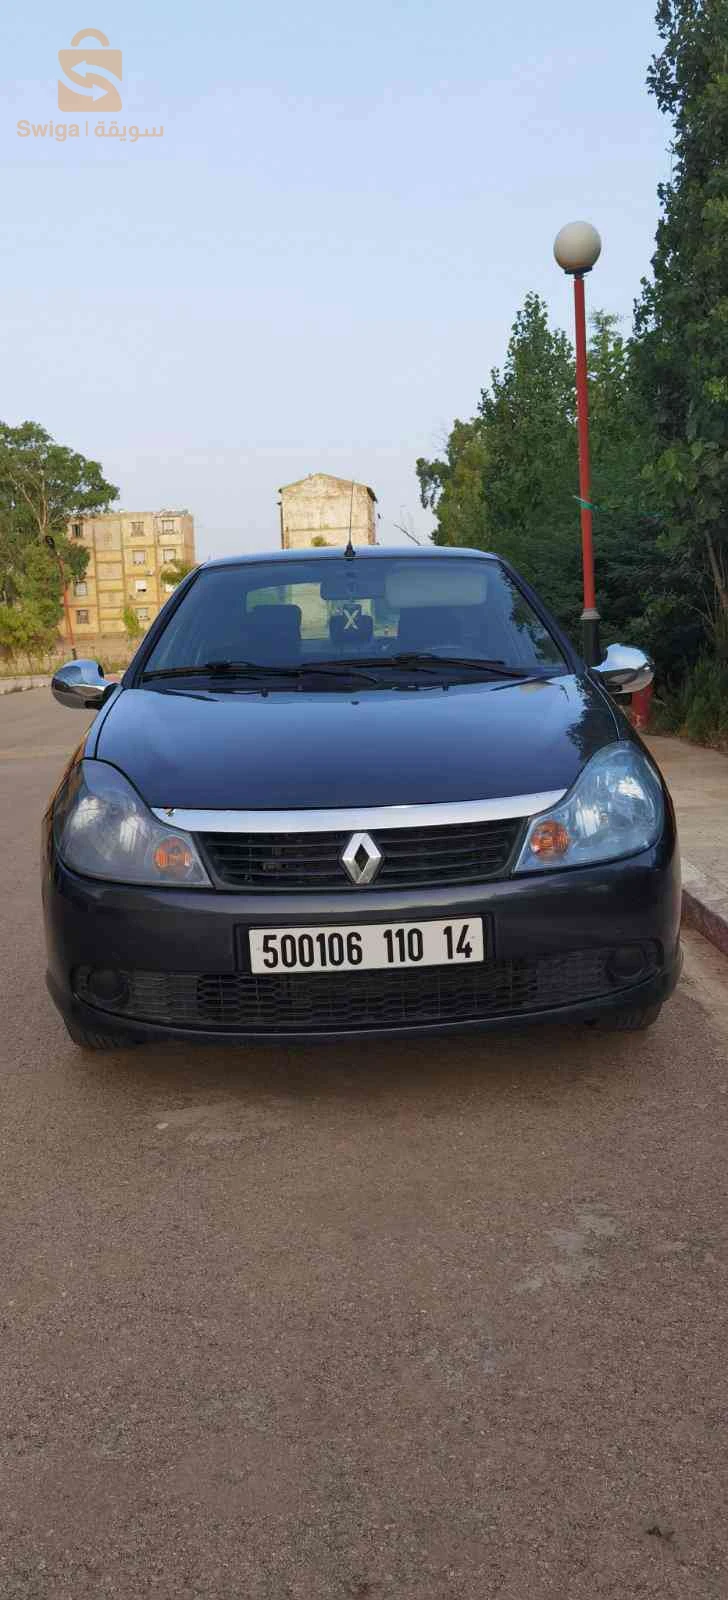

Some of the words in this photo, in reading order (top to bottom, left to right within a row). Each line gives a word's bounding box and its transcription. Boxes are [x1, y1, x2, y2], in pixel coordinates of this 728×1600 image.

[262, 931, 363, 968] 500106
[383, 927, 424, 963] 110
[443, 924, 473, 960] 14
